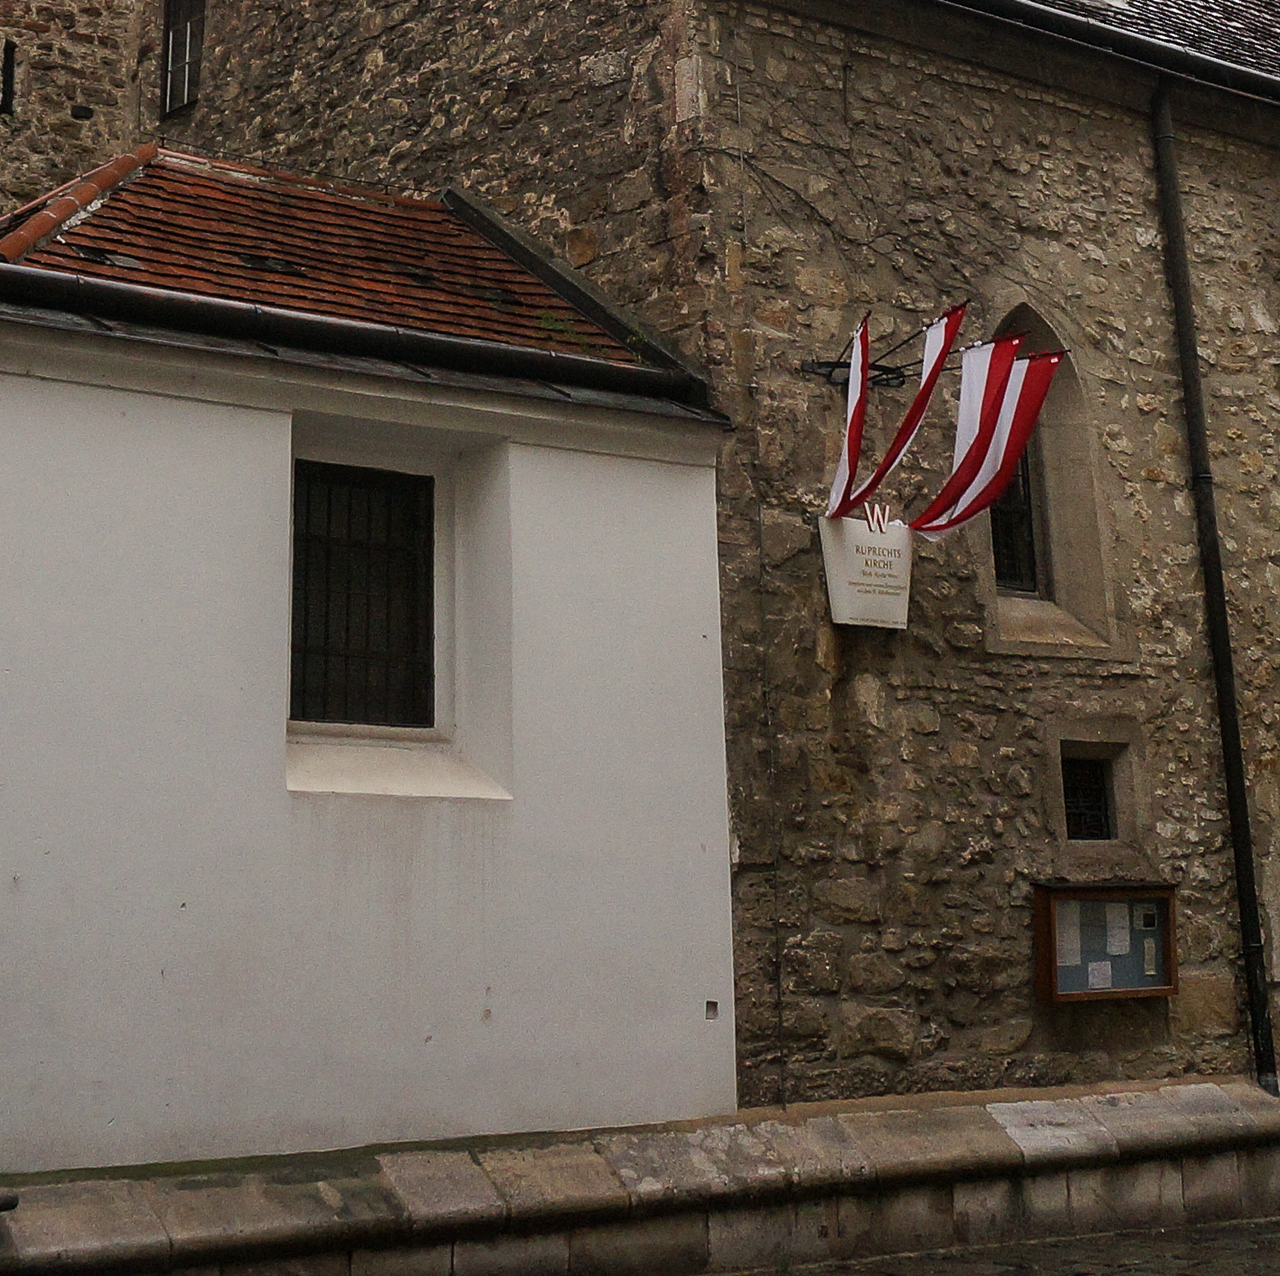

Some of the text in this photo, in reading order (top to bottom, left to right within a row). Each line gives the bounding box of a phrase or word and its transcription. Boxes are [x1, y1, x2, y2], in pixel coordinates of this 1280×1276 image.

[863, 501, 890, 534] W
[854, 544, 902, 559] RUPRECHTS
[864, 558, 894, 570] KIRCHE
